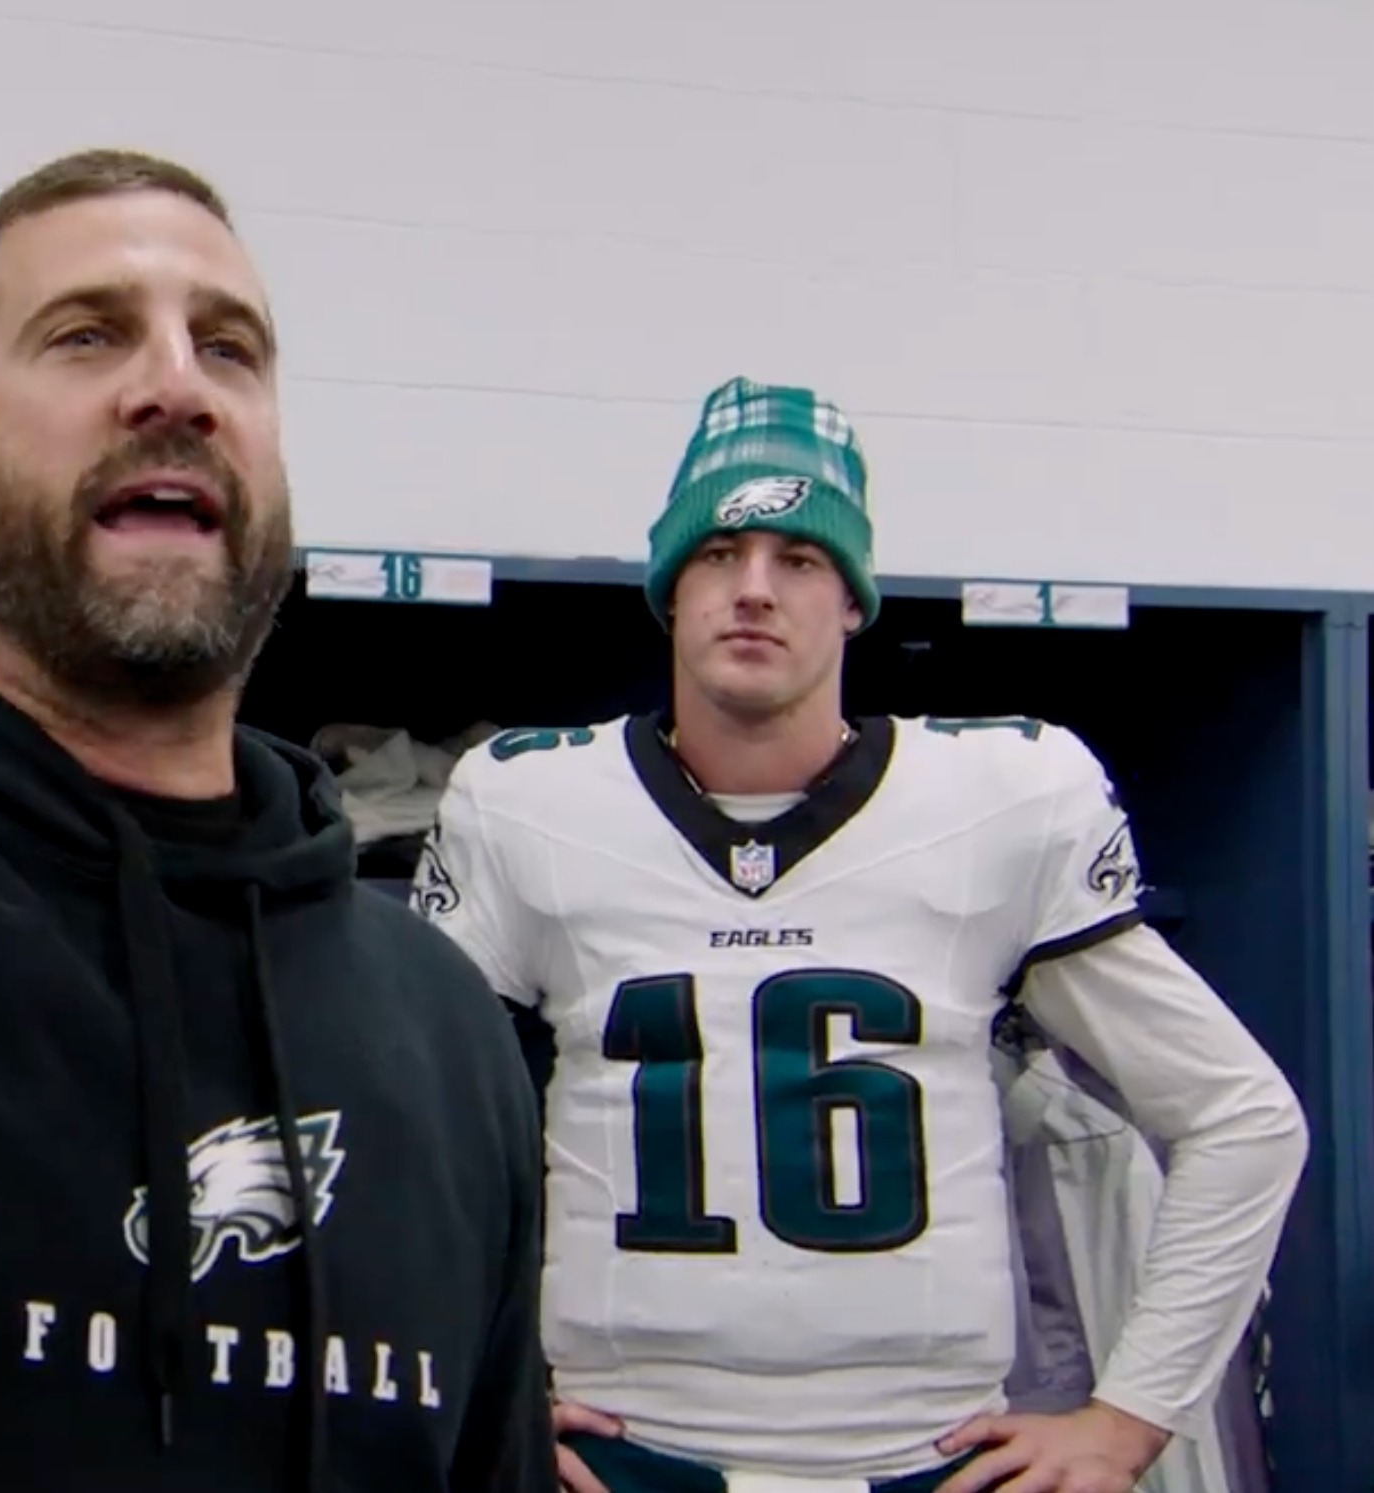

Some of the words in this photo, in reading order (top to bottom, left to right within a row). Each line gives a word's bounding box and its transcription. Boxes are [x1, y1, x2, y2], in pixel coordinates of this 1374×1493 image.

[380, 553, 422, 599] 16
[1036, 581, 1056, 625] 1
[709, 928, 814, 948] EAGLES
[602, 967, 928, 1254] 16
[24, 1301, 441, 1408] FOTBALL
